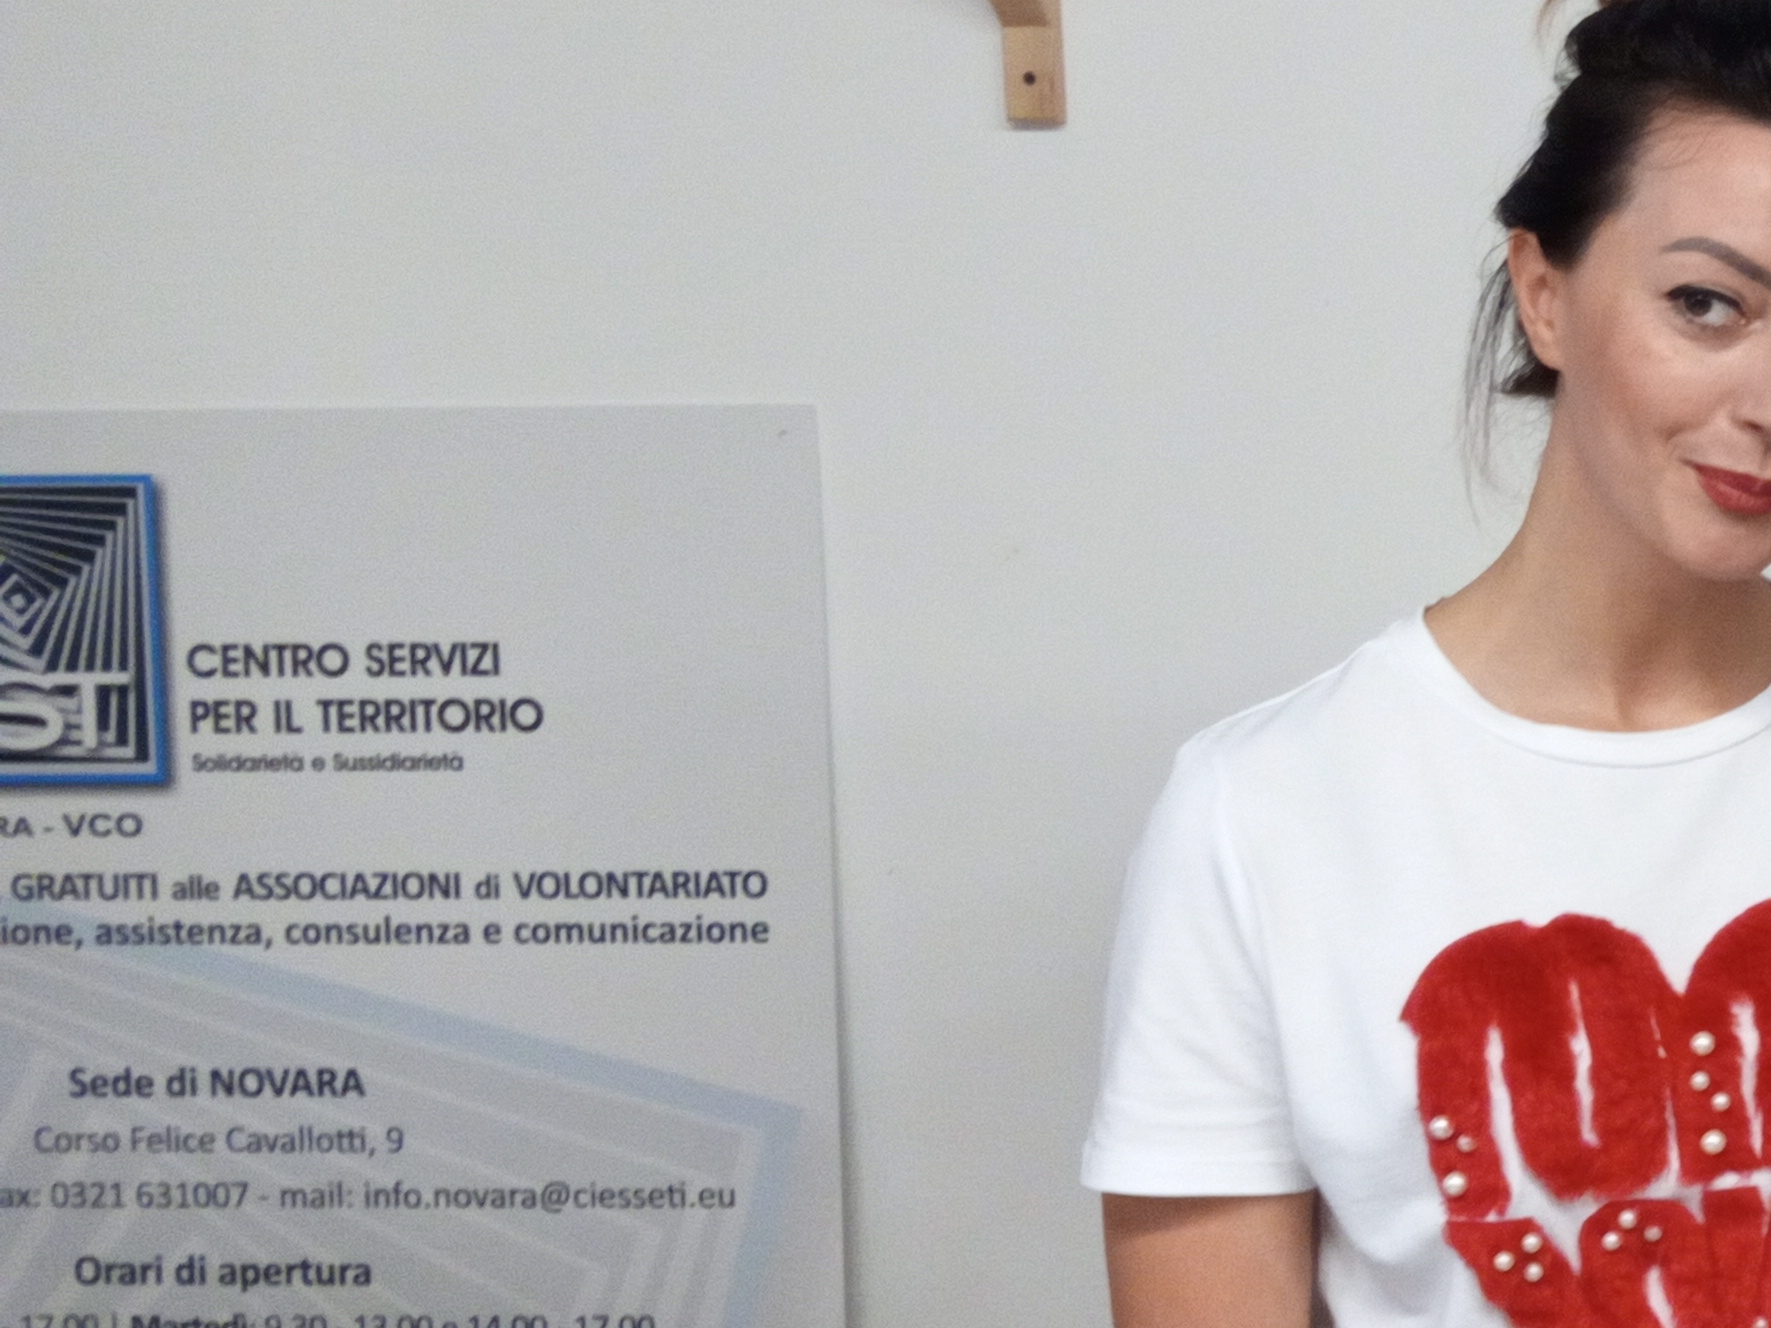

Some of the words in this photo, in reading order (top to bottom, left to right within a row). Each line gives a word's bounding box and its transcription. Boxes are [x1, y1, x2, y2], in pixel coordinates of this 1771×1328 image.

[187, 642, 350, 678] CENTRO
[365, 642, 500, 676] SERVIZI
[190, 699, 258, 734] PER
[274, 699, 303, 734] IL
[316, 697, 544, 734] TERRITORIO
[311, 758, 325, 772] e
[62, 813, 143, 838] VCO
[10, 872, 158, 902] GRATUITI
[172, 875, 220, 902] alle
[233, 871, 462, 902] ASSOCIAZIONI
[475, 874, 499, 900] di
[513, 870, 769, 900] VOLONTARIATO
[95, 917, 273, 950] assistenza,
[285, 916, 471, 946] consulenza
[482, 922, 501, 945] e
[513, 915, 770, 945] comunicazione
[68, 1066, 154, 1099] Sede
[166, 1066, 199, 1099] di
[210, 1067, 366, 1099] NOVARA
[34, 1126, 121, 1154] Corso
[131, 1125, 216, 1154] Felice
[226, 1125, 377, 1159] Cavallotti,
[386, 1126, 404, 1154] 9
[51, 1181, 125, 1209] 0321
[136, 1181, 249, 1209] 631007
[279, 1180, 354, 1209] mail:
[364, 1180, 736, 1214] info.novara@ciesseti.eu
[74, 1255, 163, 1287] Orari
[175, 1254, 207, 1287] di
[218, 1257, 373, 1293] apertura
